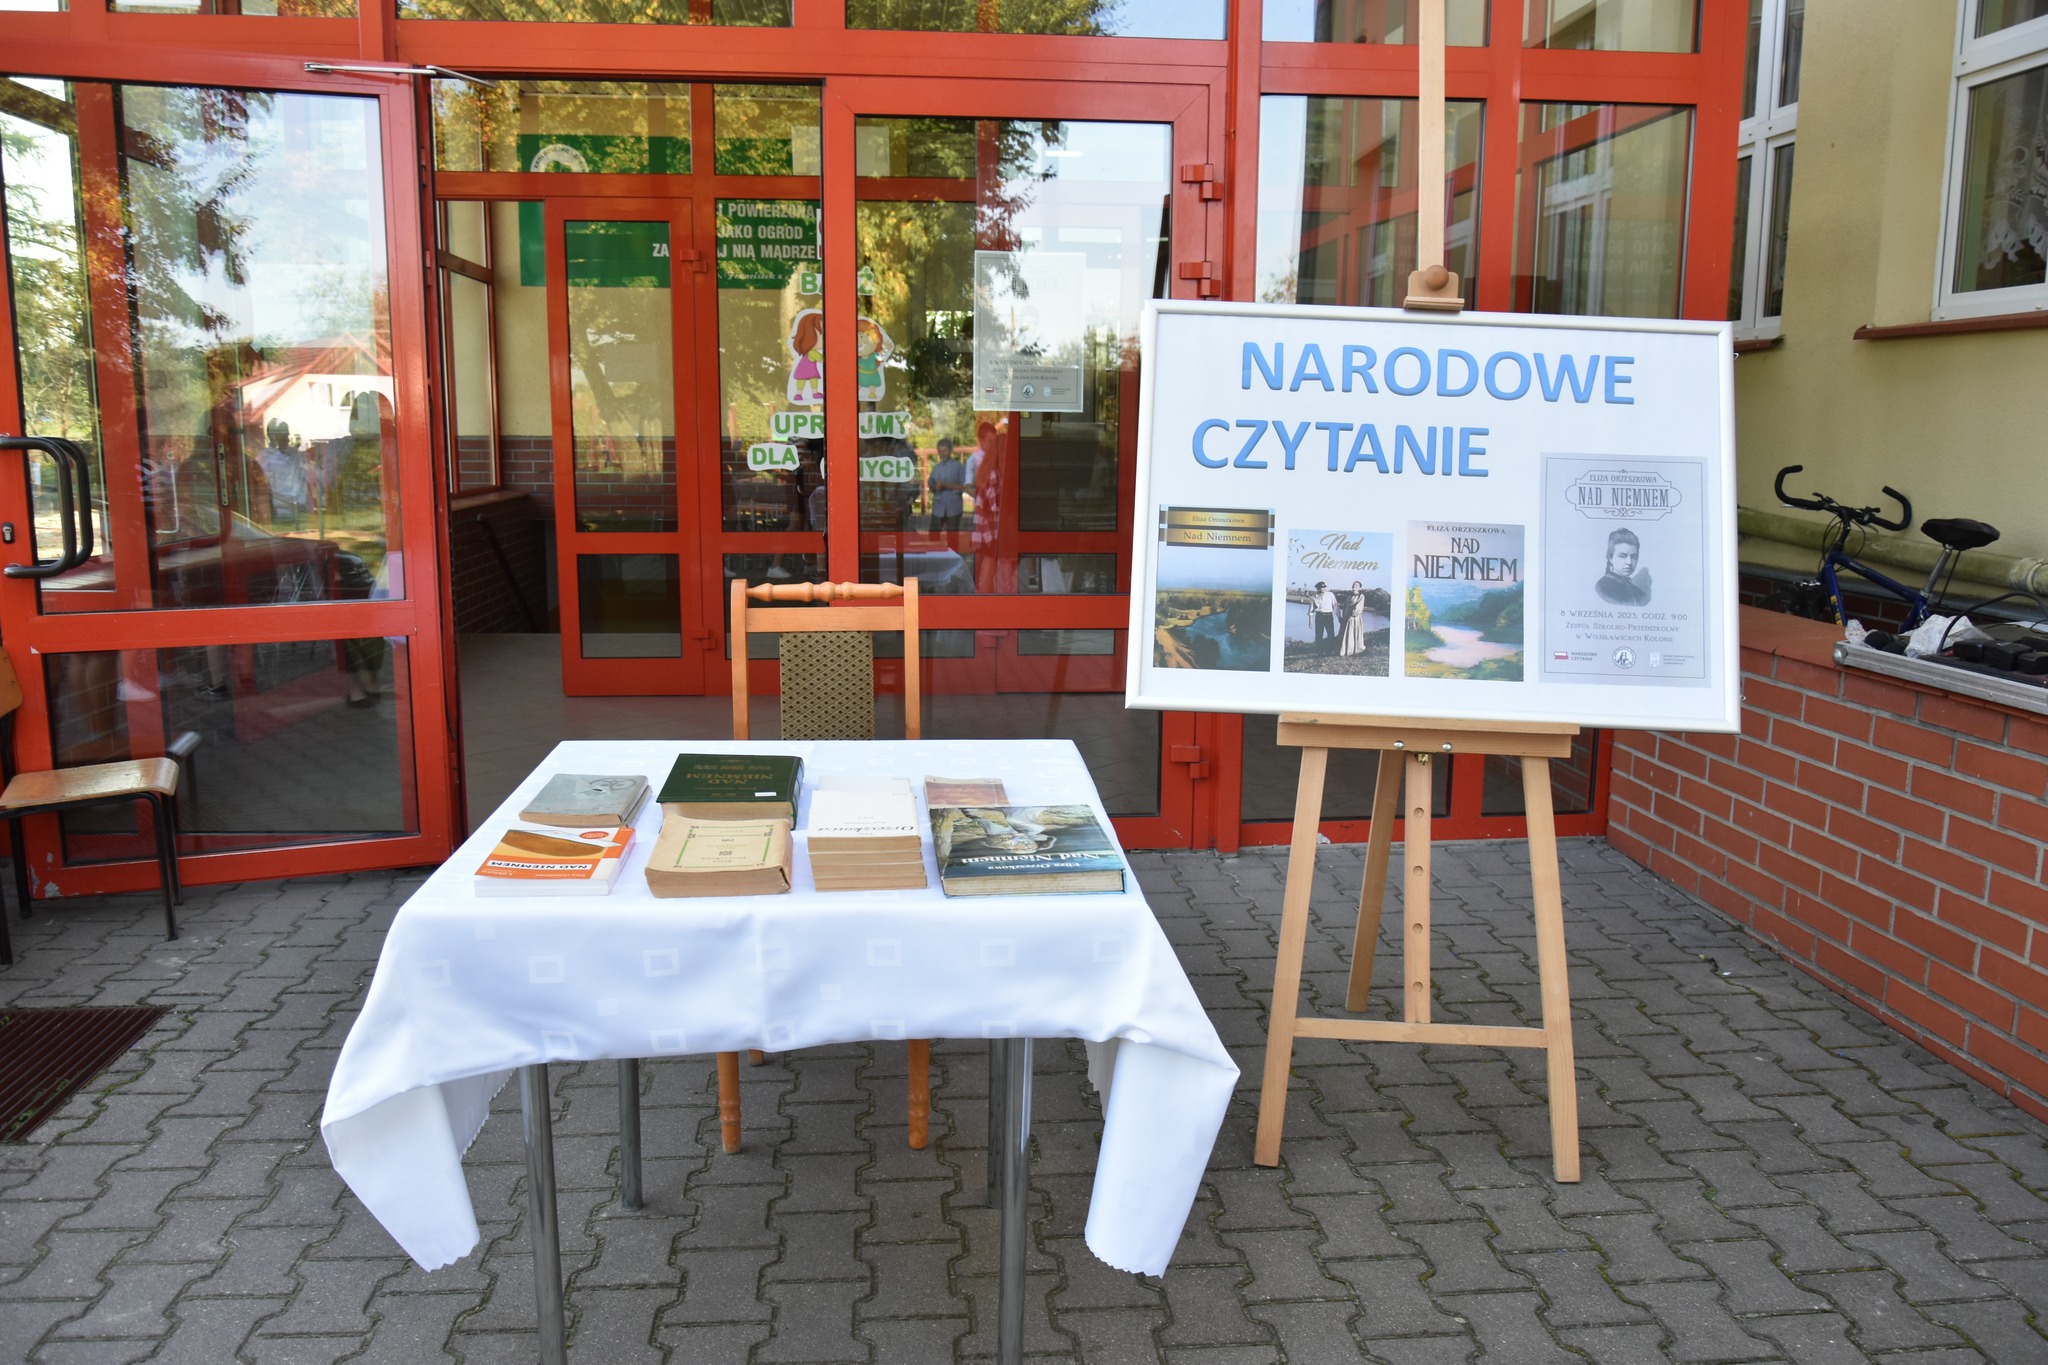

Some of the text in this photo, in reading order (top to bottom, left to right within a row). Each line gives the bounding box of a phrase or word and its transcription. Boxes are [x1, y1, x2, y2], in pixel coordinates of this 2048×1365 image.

[728, 203, 816, 219] POWIERZONA
[732, 244, 756, 261] NIĄ
[760, 244, 816, 262] MĄDRZE
[1241, 341, 1635, 405] NARODOWE
[774, 414, 910, 435] UPRJMY
[752, 447, 797, 466] DLA
[1192, 418, 1490, 478] CZYTANIE
[1589, 475, 1658, 484] ELIZA ORZESZKOWA
[1578, 486, 1670, 508] NAD NIEMNEM
[1192, 515, 1245, 524] Eliza Orzeszkowa
[1183, 531, 1252, 543] Nad Niemnem
[1427, 525, 1506, 535] ELIZA ORZESZKOWA
[1319, 533, 1365, 551] Nad
[1450, 537, 1480, 554] NAD
[1300, 551, 1379, 571] Niemnem
[1413, 554, 1519, 582] NIEMNEM
[1569, 609, 1614, 620] WRZEŚNIA
[1641, 612, 1668, 621] GODZ.
[490, 861, 556, 870] NIEMNEM
[961, 851, 1101, 865] Nad Niemnem
[987, 861, 1081, 872] Eliza Orzeszkowa
